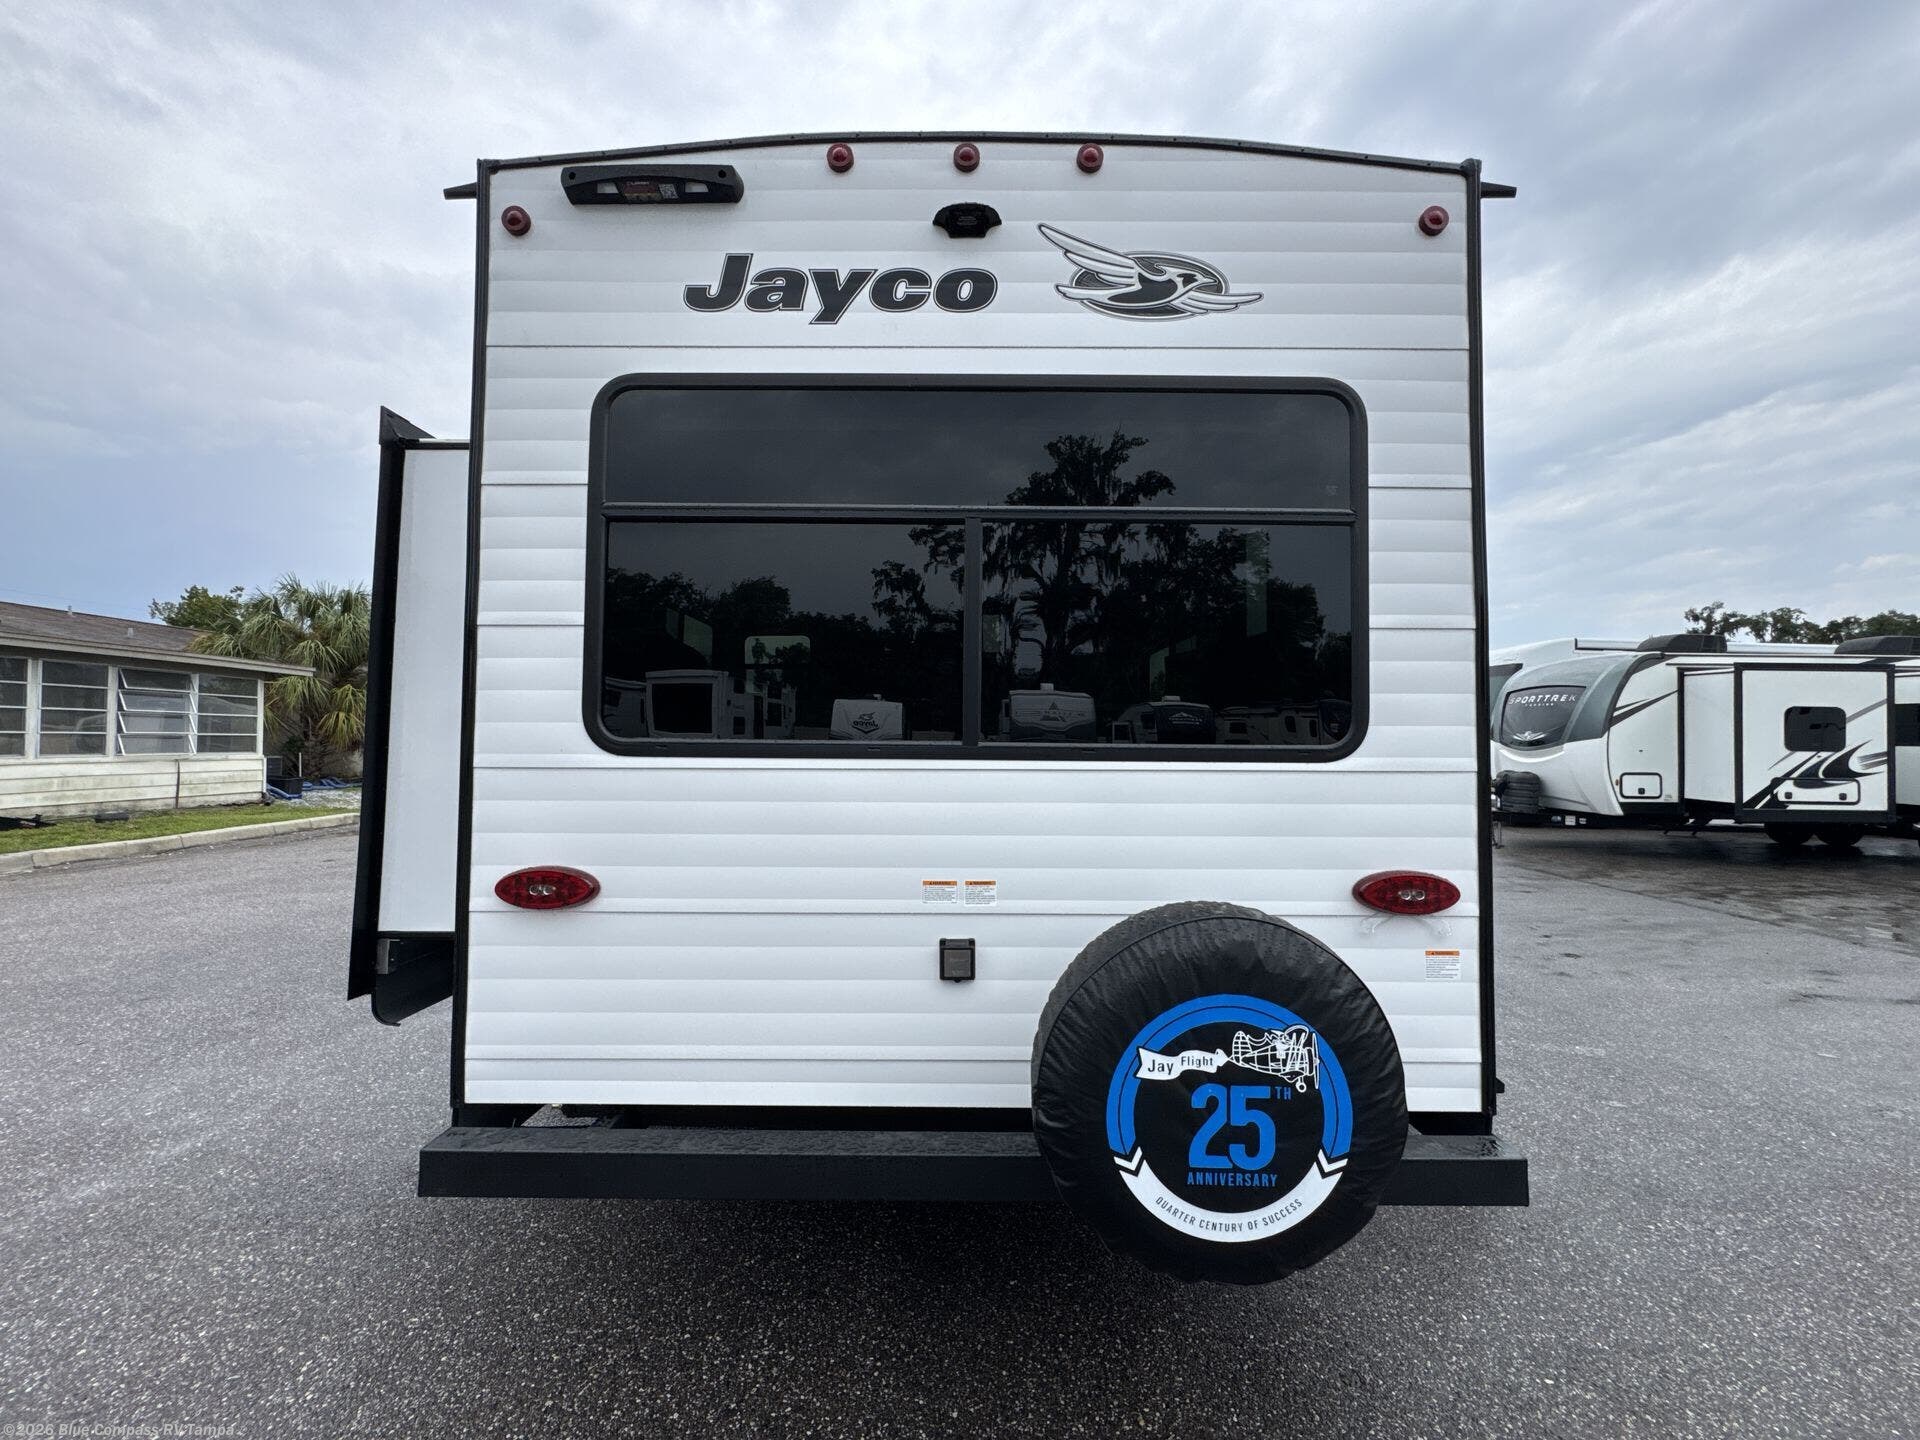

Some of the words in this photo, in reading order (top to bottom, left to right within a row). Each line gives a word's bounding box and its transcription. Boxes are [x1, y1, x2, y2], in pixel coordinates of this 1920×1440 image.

[683, 252, 998, 325] Jayco
[1508, 694, 1577, 705] SPORTTREK
[1147, 1059, 1174, 1075] Jay
[1180, 1055, 1214, 1067] Flight
[1187, 1172, 1278, 1187] ANNIVERSARY
[1155, 1196, 1196, 1226] QUARTER
[1198, 1218, 1243, 1233] CENTURY
[1247, 1219, 1259, 1231] OF
[1263, 1198, 1303, 1226] SUCCESS
